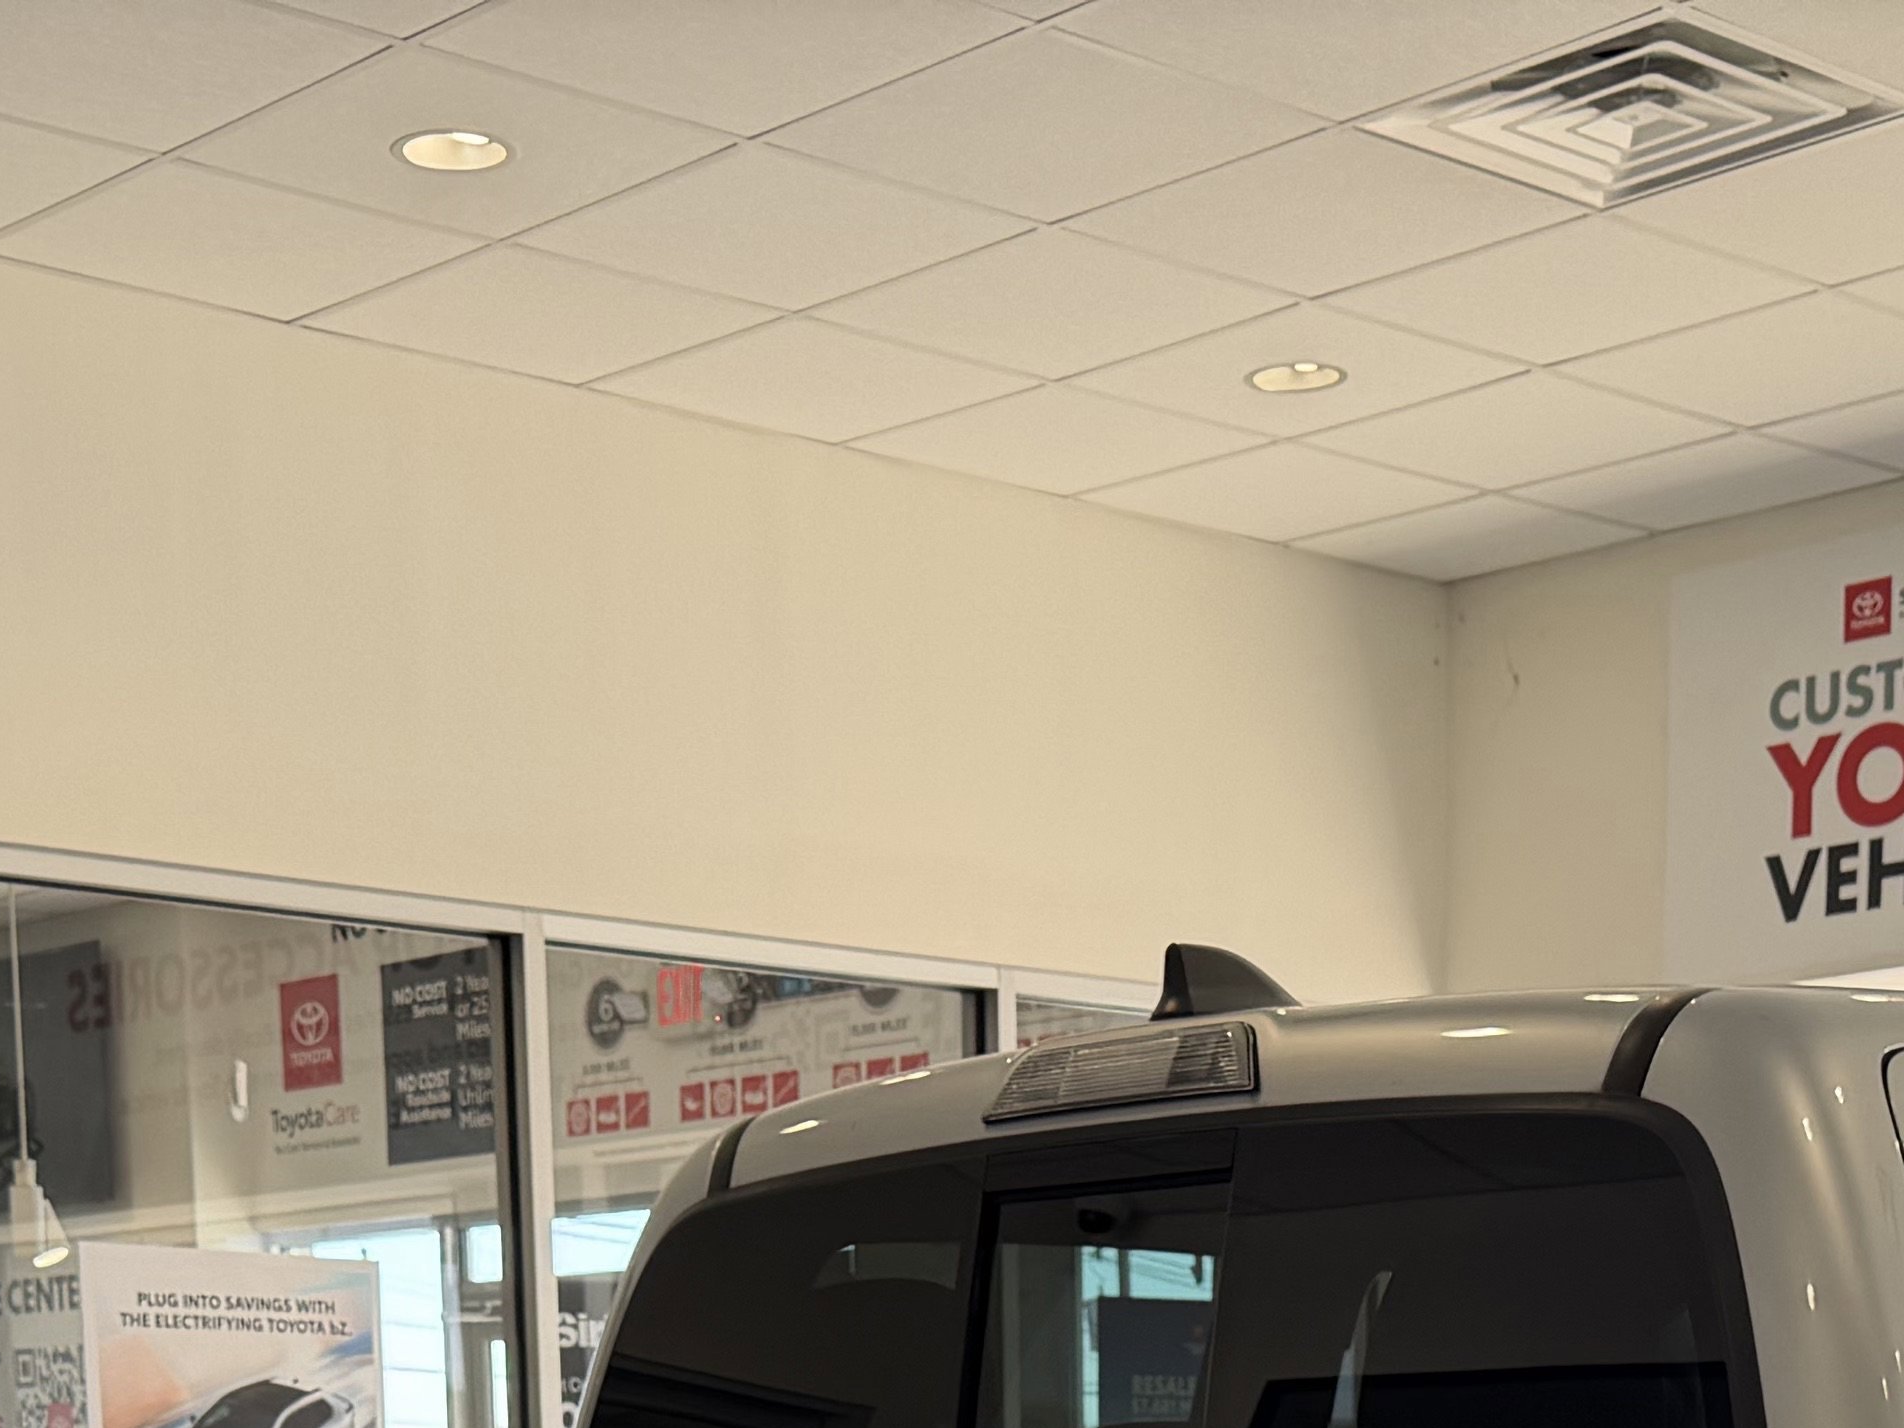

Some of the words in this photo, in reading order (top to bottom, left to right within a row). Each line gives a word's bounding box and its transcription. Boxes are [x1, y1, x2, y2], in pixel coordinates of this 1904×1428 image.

[392, 988, 412, 1006] NO
[413, 980, 448, 1001] COST
[289, 1047, 334, 1067] TOYOTA
[397, 1075, 417, 1092] NO
[418, 1068, 451, 1090] COST
[271, 1102, 360, 1137] ToyotaCare
[137, 1292, 179, 1308] PLUG
[183, 1294, 221, 1310] INTO
[225, 1296, 292, 1313] SAVINGS
[296, 1299, 335, 1315] WITH
[120, 1312, 151, 1327] THE
[155, 1314, 264, 1333] ELECTRIFYING
[267, 1318, 327, 1335] TOYOTA
